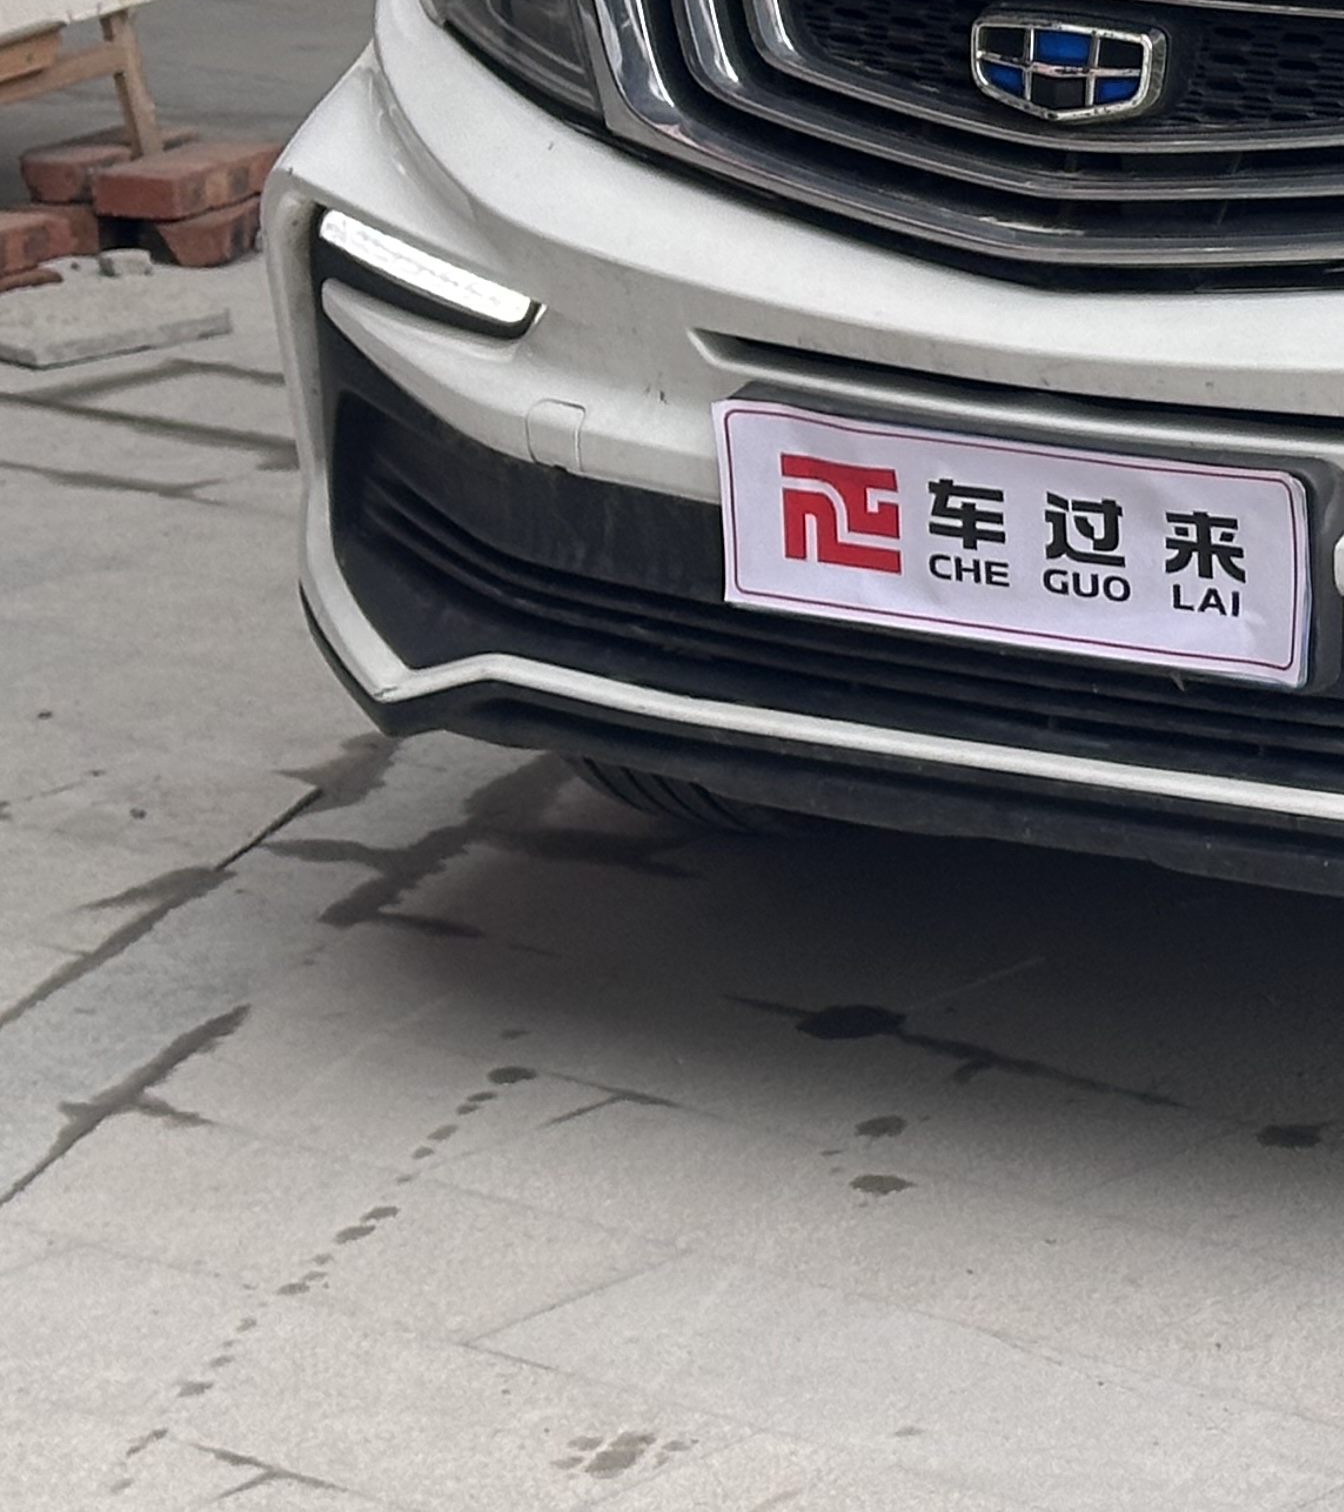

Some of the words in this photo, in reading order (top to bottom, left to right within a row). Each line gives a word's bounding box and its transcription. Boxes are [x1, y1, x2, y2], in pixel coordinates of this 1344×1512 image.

[928, 478, 1247, 583] 车过来
[929, 554, 1010, 587] CHE
[1042, 568, 1132, 602] GUO
[1172, 584, 1241, 617] LAI
